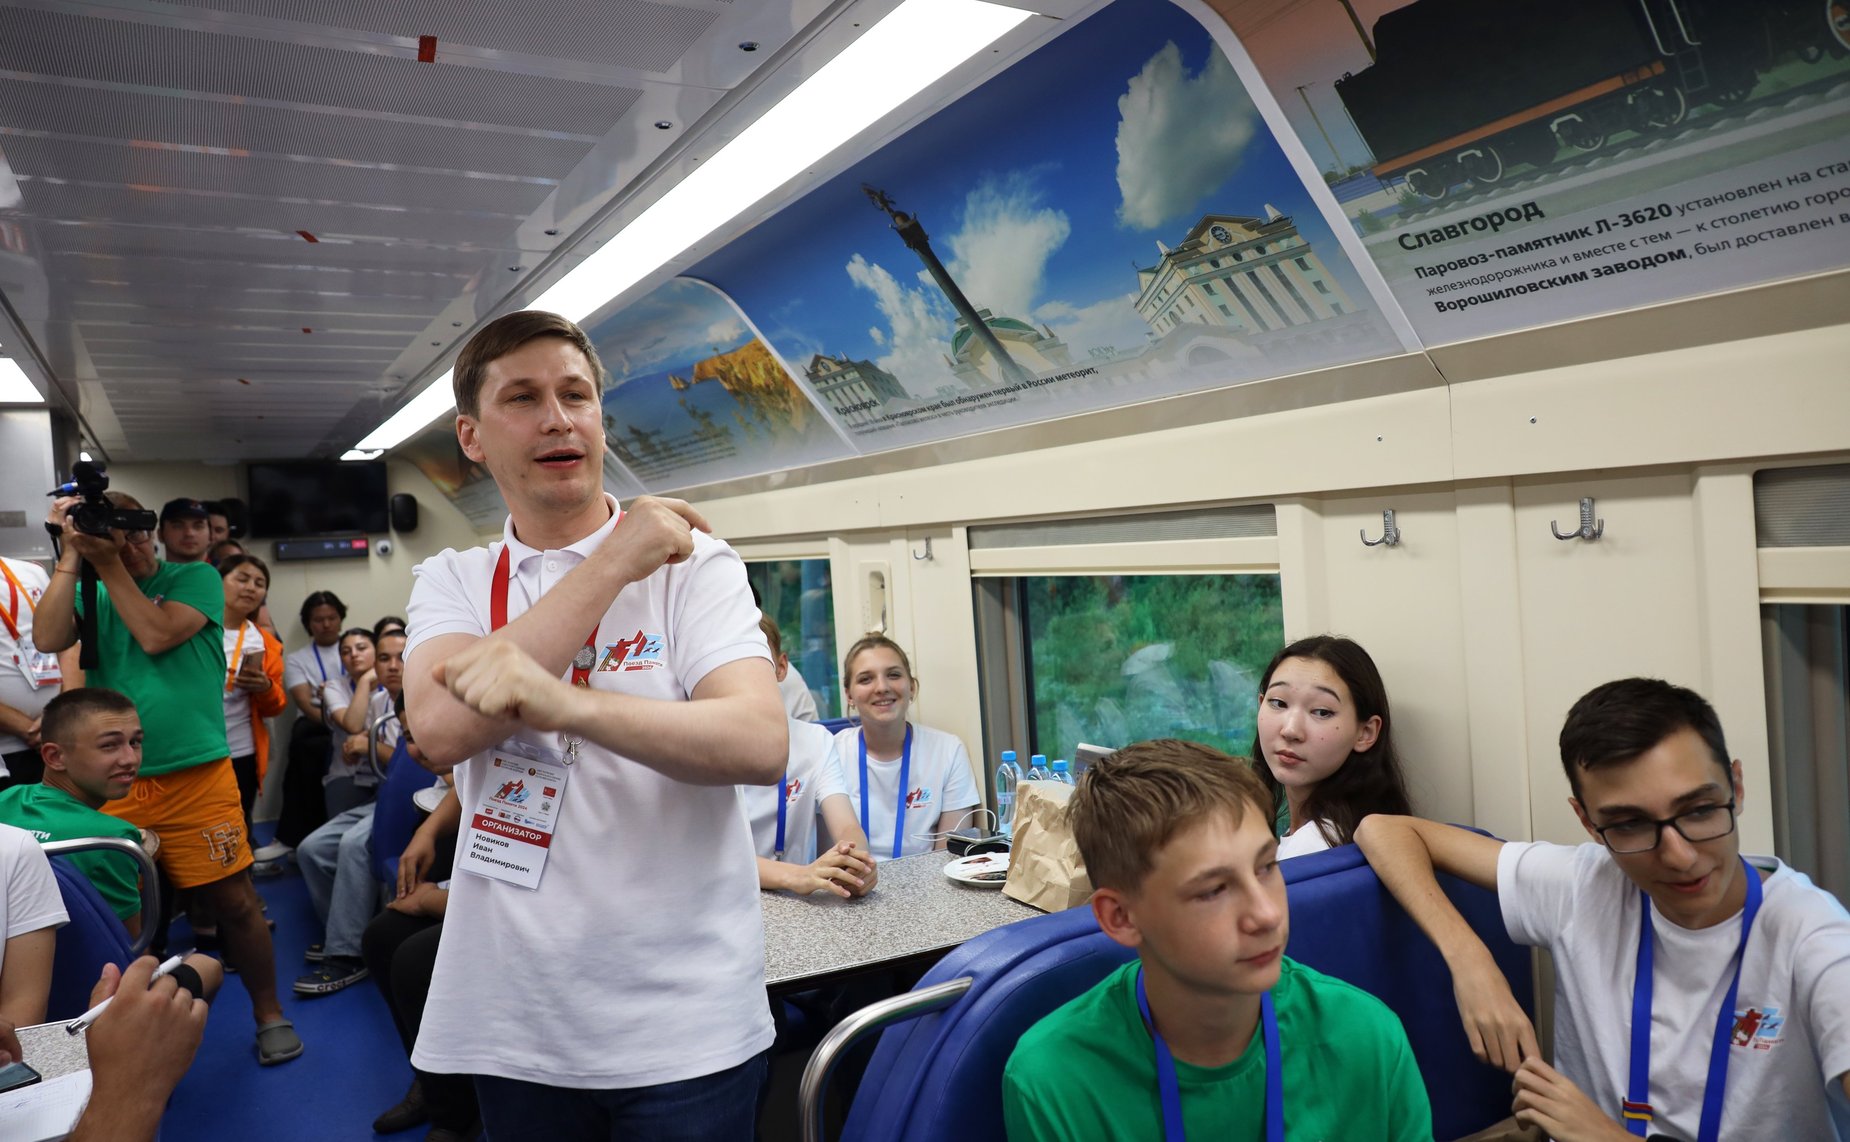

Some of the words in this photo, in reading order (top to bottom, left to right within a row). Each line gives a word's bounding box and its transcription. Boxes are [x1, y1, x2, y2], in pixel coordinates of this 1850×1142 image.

[1398, 201, 1545, 251] Славгород
[1414, 226, 1593, 279] Паровоз-памятник
[1595, 203, 1672, 234] Л-3620
[1675, 180, 1783, 217] установлен
[1787, 171, 1812, 186] на
[1816, 160, 1850, 179] ста
[1426, 258, 1557, 296] железнодорожника
[1560, 255, 1571, 265] и
[1573, 241, 1627, 262] вместе
[1630, 239, 1639, 248] с
[1640, 231, 1673, 245] тем
[1696, 221, 1708, 233] к
[1710, 200, 1800, 229] столетию
[1434, 271, 1589, 313] Ворошиловским
[1591, 248, 1693, 278] заводом,
[1694, 239, 1732, 256] был
[1736, 215, 1834, 249] доставлен
[956, 390, 993, 405] обнаружен
[993, 383, 1021, 398] первый
[1027, 377, 1055, 389] России
[1055, 367, 1100, 383] метеорит,
[834, 398, 880, 417] Красноярск
[475, 833, 509, 848] Новиков
[481, 819, 542, 841] ОРГАНИЗАТОР
[470, 851, 530, 873] Владимирович
[472, 842, 493, 853] Иван
